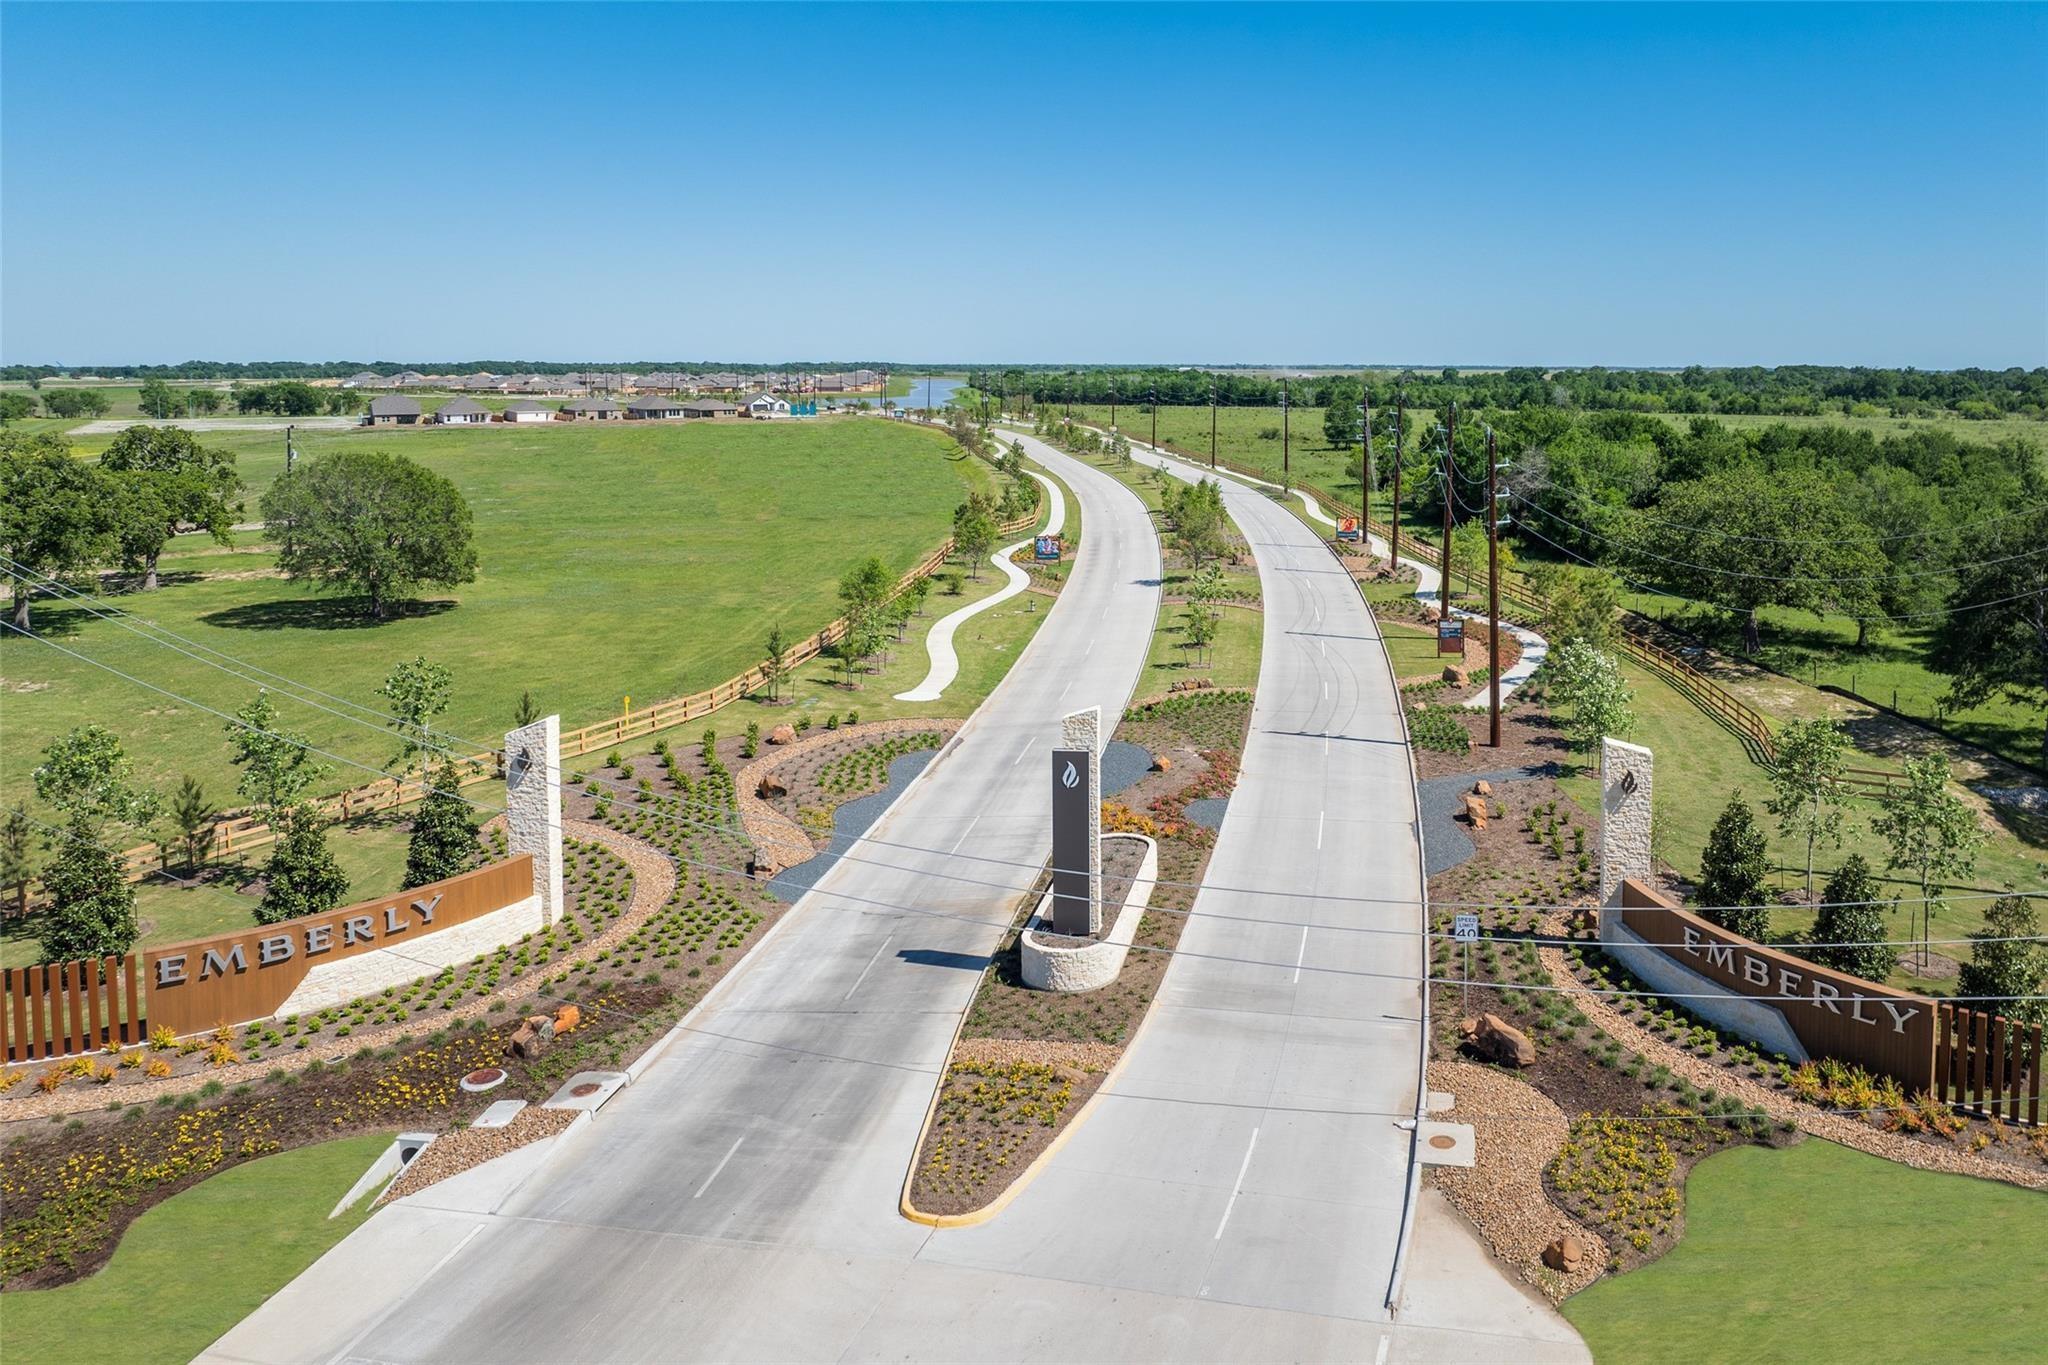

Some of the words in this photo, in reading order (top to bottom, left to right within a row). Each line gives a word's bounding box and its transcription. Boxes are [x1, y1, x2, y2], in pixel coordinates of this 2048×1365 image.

[157, 895, 443, 986] EMBERLY
[1457, 929, 1476, 937] 40
[1683, 927, 1919, 1034] EMBERLY
